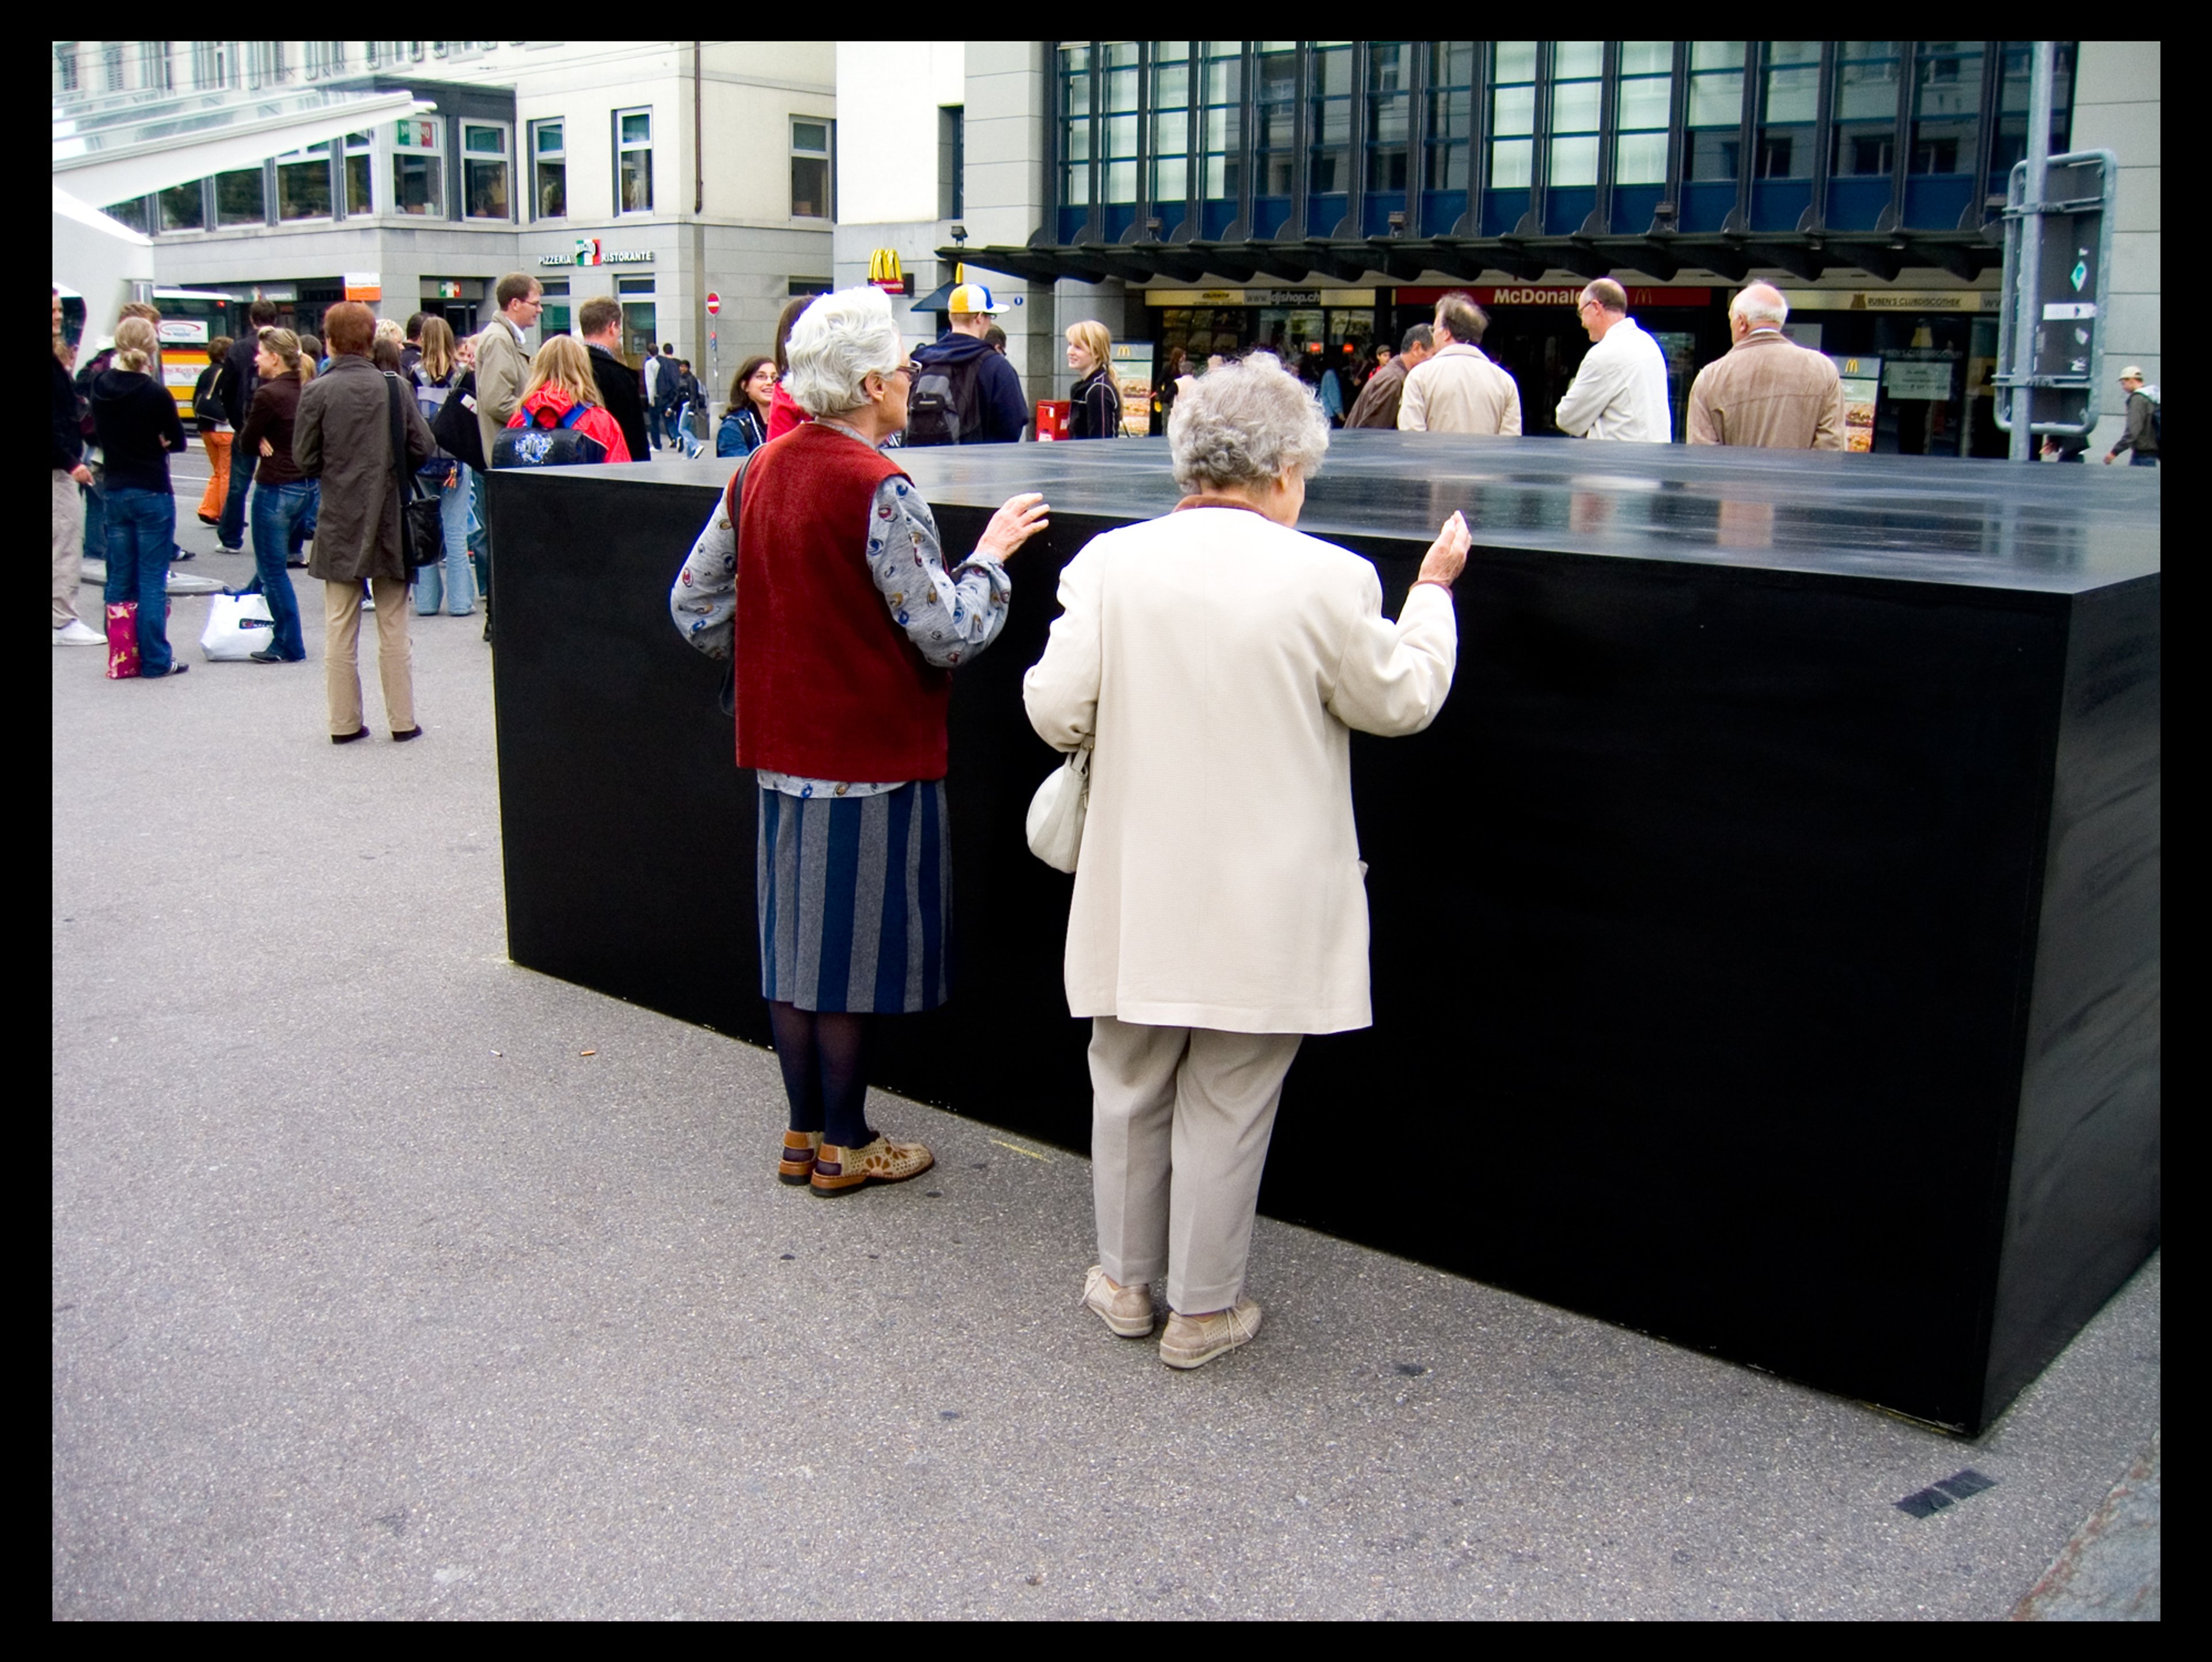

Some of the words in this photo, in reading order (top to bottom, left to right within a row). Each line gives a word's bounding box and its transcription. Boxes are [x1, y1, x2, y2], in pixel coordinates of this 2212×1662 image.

[539, 255, 572, 264] PIZZERIA
[601, 251, 652, 262] RISTORANTE
[1271, 290, 1320, 305] djshop.ch
